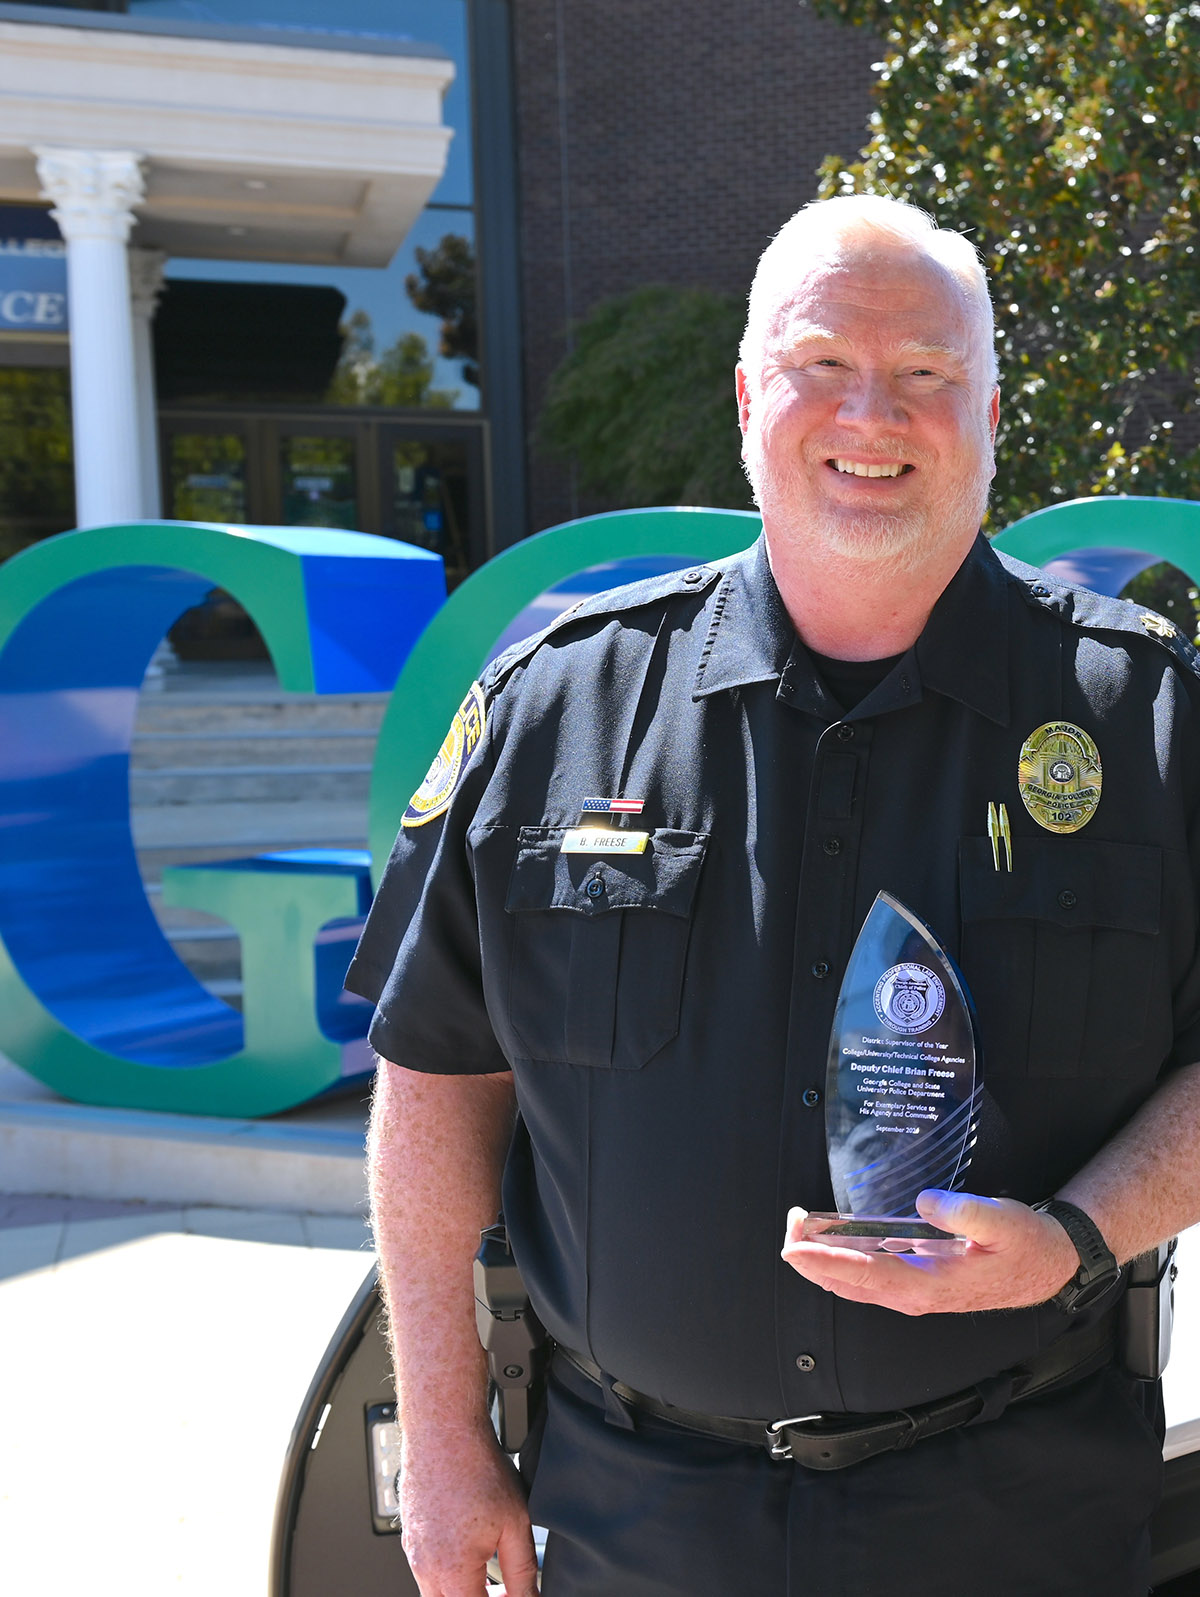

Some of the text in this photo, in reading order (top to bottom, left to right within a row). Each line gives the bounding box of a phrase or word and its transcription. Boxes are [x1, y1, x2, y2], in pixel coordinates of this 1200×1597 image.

[1044, 724, 1083, 737] MAJOR
[1027, 784, 1094, 800] GEORGIA COLLEGE
[1047, 800, 1076, 809] POLICE
[1051, 812, 1072, 821] 102
[580, 837, 628, 847] B. FREESE
[885, 1039, 916, 1048] Supervisor
[935, 1042, 949, 1050] Year
[920, 1054, 940, 1063] College
[940, 1056, 966, 1064] Agencies
[850, 1062, 955, 1078] Deputy Chief Brian Freese
[863, 1078, 888, 1087] Georgia
[888, 1080, 911, 1089] College
[924, 1082, 941, 1090] State
[856, 1085, 945, 1098] University Police Department
[875, 1101, 905, 1110] Exemplary
[906, 1103, 927, 1111] Service
[870, 1109, 892, 1118] Agency
[904, 1111, 939, 1121] Community
[875, 1125, 905, 1133] September
